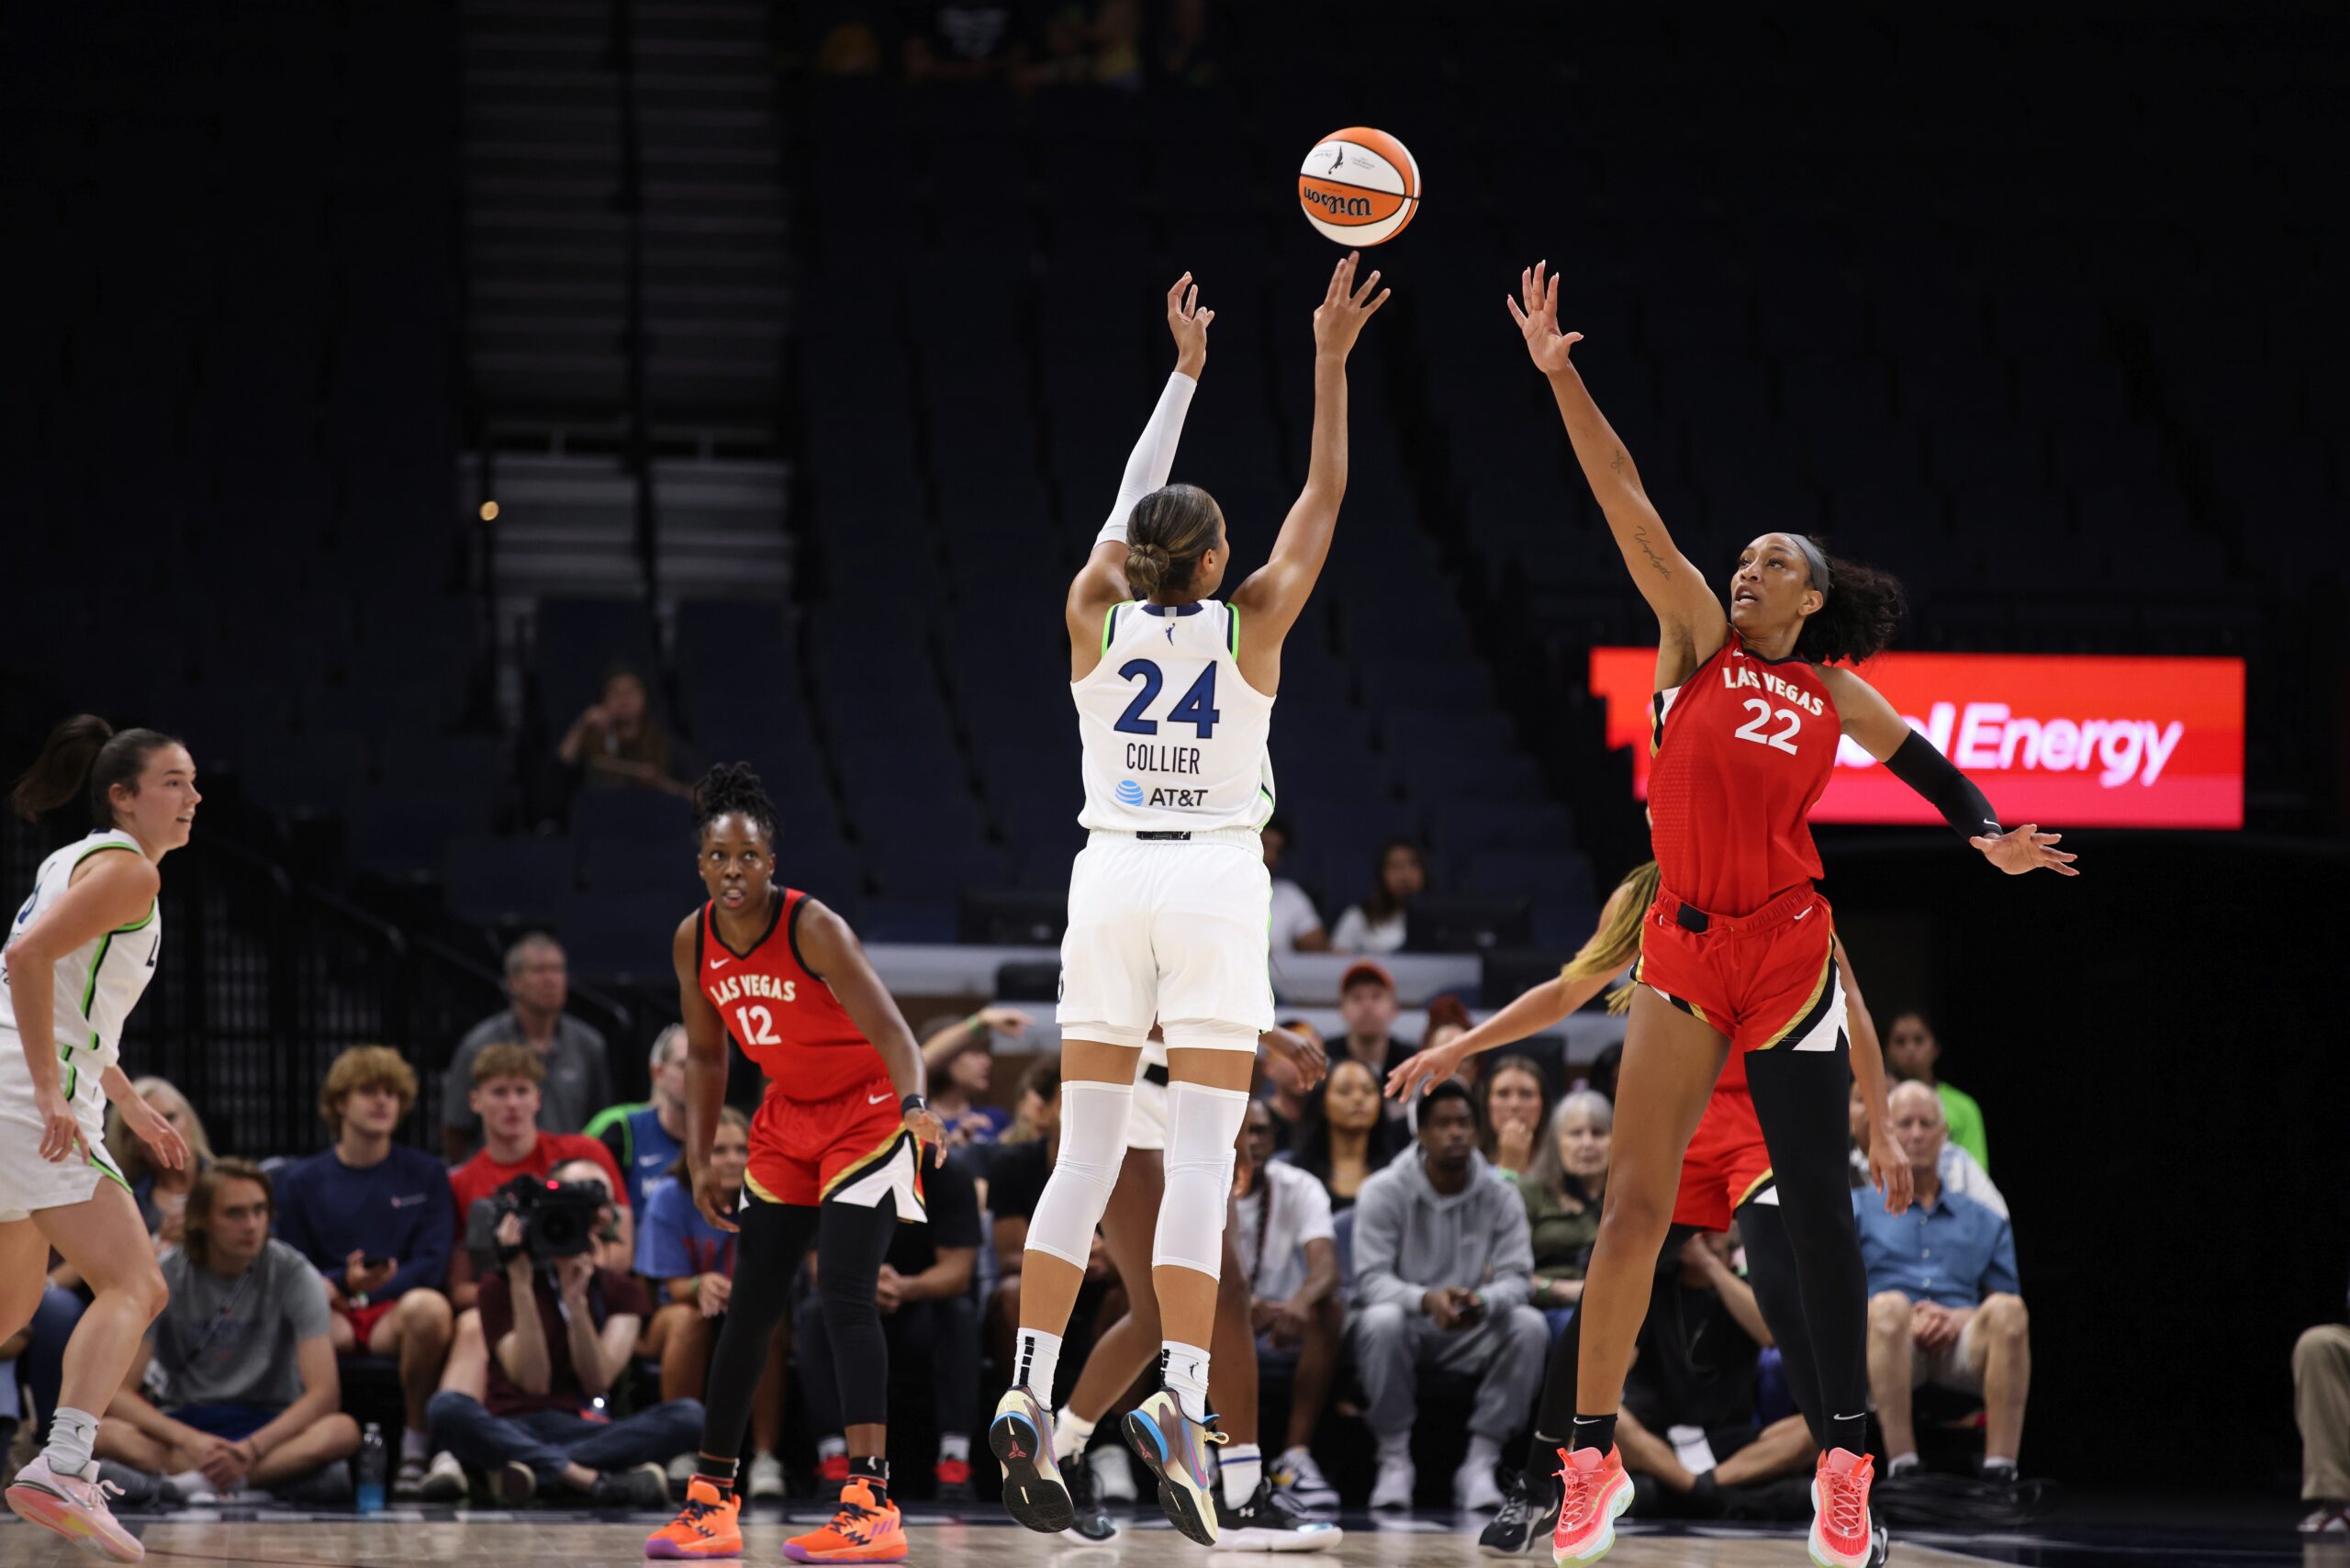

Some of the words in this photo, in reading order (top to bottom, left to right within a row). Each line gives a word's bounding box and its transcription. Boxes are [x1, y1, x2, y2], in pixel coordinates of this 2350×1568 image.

[1304, 185, 1372, 217] Wilson
[1113, 658, 1220, 739] 24
[1722, 666, 1761, 689] LAS
[1762, 671, 1824, 716] VEGAS
[1734, 698, 1801, 756] 22
[1954, 701, 2184, 789] Energy
[1126, 743, 1201, 774] COLLIER
[1148, 788, 1208, 806] AT&T
[710, 976, 741, 1006] LAS
[739, 974, 796, 1002] VEGAS
[735, 1004, 782, 1045] 12
